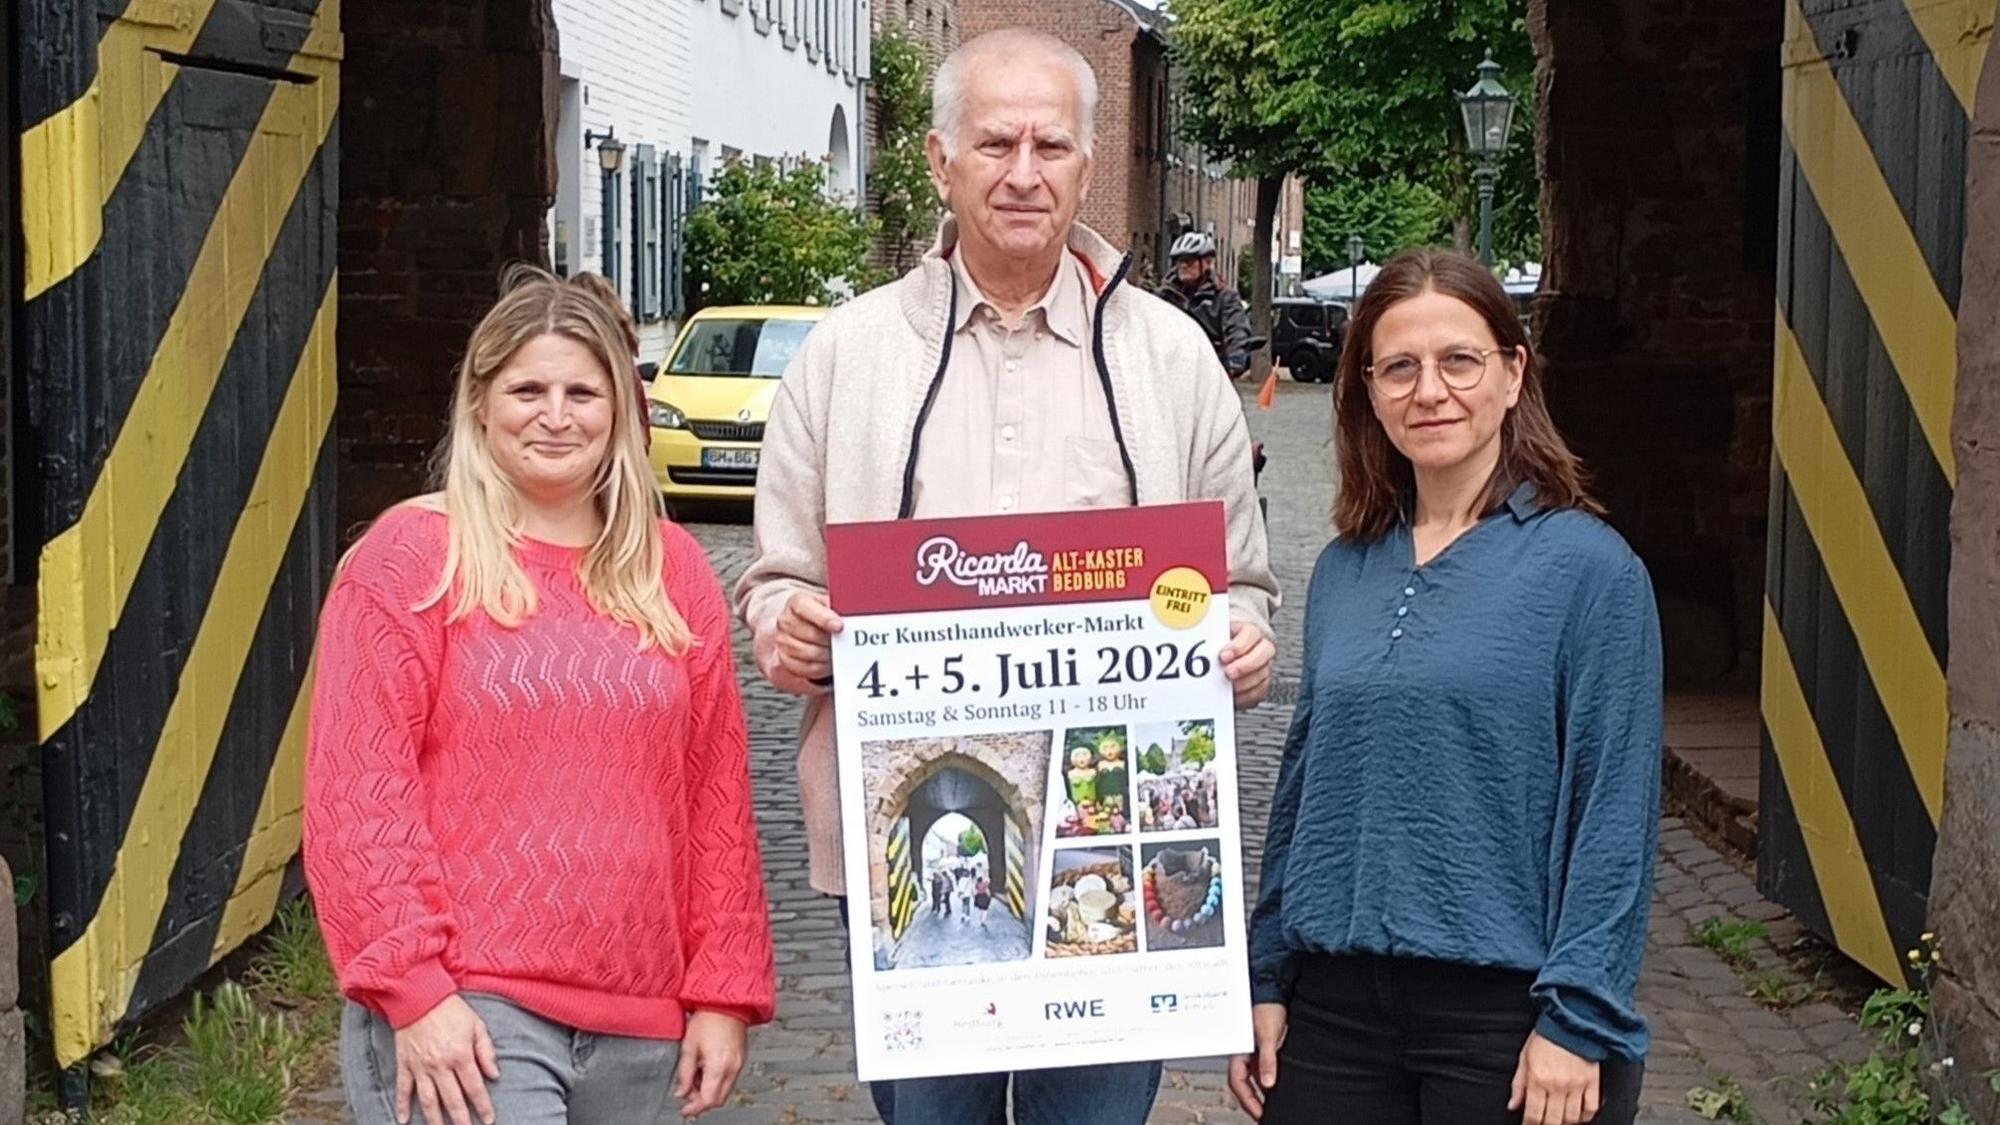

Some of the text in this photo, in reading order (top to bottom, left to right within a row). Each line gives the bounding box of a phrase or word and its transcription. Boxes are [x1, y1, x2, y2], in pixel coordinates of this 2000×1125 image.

[916, 537, 1048, 586] Ricarda
[1052, 547, 1144, 572] ALT-KASTER
[978, 575, 1048, 597] MARKT
[1053, 570, 1126, 592] BEDBURG
[1155, 583, 1207, 604] EINTRITT
[1166, 597, 1192, 614] FREI
[853, 614, 1144, 646] Der Kunsthandwerker-Markt
[941, 654, 982, 695] 5.
[996, 648, 1081, 698] Juli
[1097, 639, 1212, 685] 2026
[857, 709, 936, 727] Samstag
[943, 707, 958, 722] &
[964, 703, 1042, 720] Sonntag
[1049, 699, 1067, 715] 11
[1088, 696, 1108, 713] 18
[1113, 693, 1148, 711] Uhr
[1045, 999, 1105, 1021] RWE
